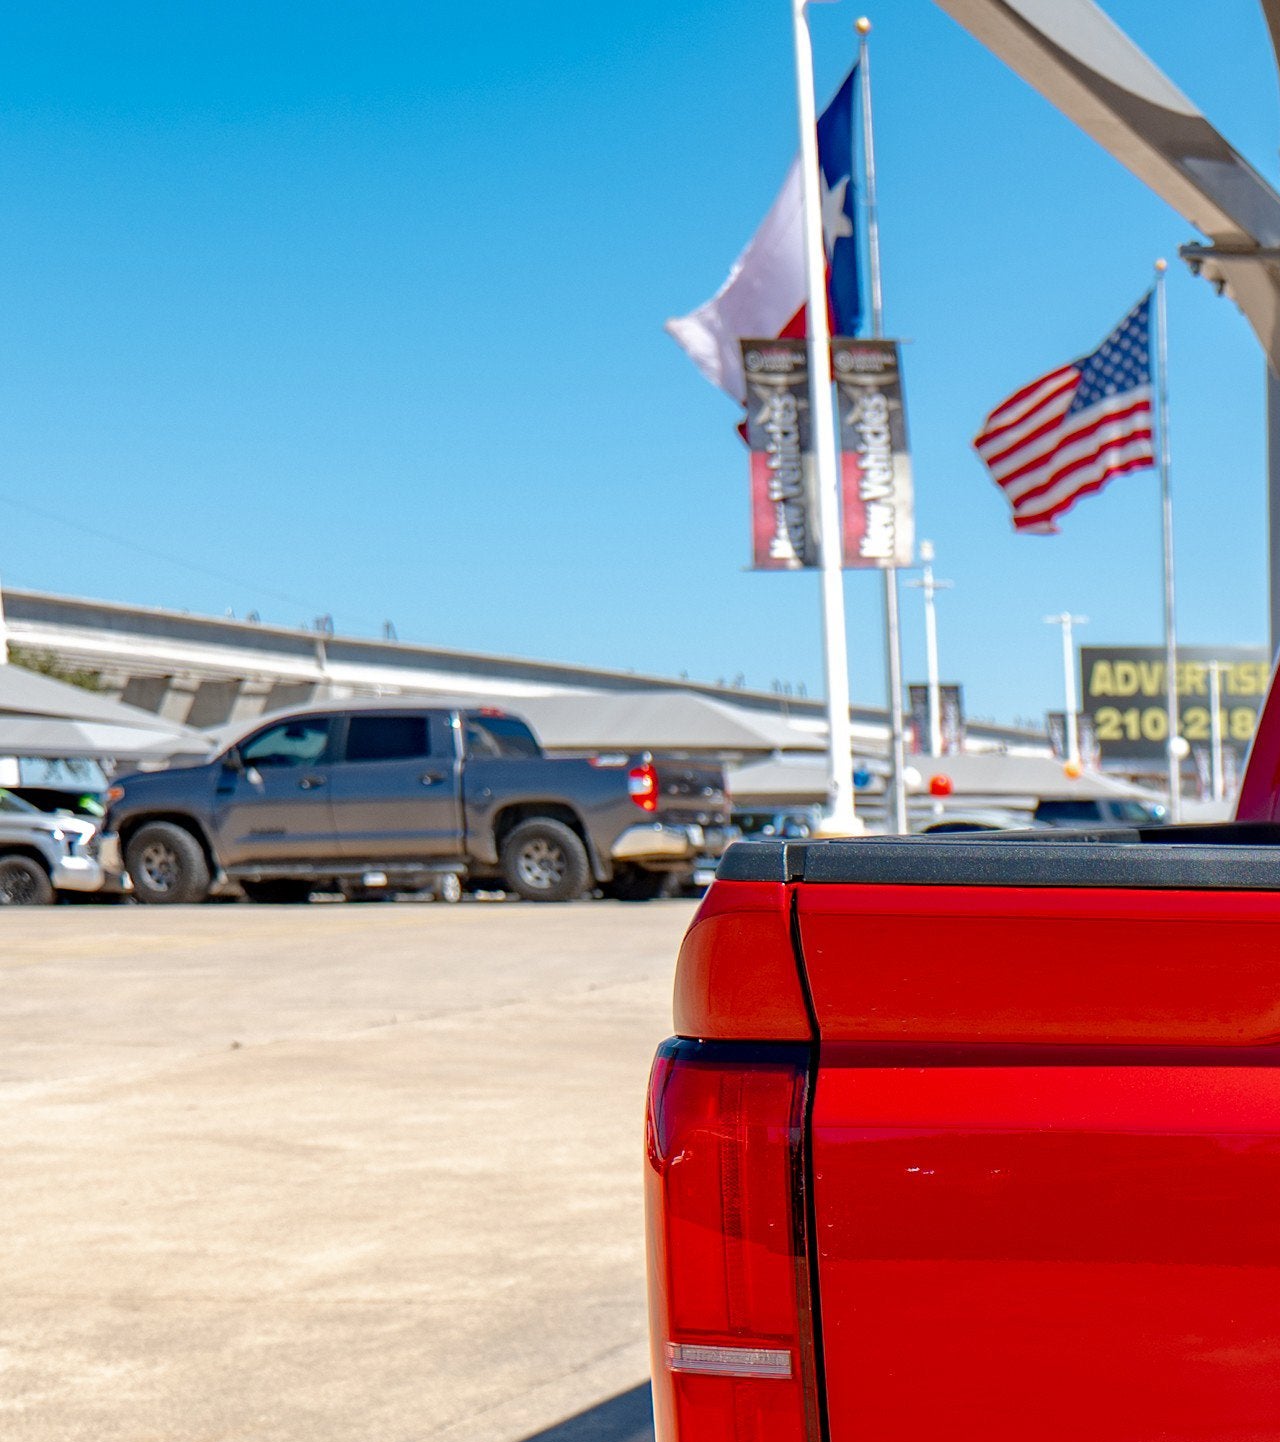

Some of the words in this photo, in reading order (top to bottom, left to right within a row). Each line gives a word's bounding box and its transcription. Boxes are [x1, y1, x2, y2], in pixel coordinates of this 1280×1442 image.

[855, 392, 893, 501] Vehicles
[860, 502, 895, 558] New
[1089, 660, 1271, 697] ADVRIS
